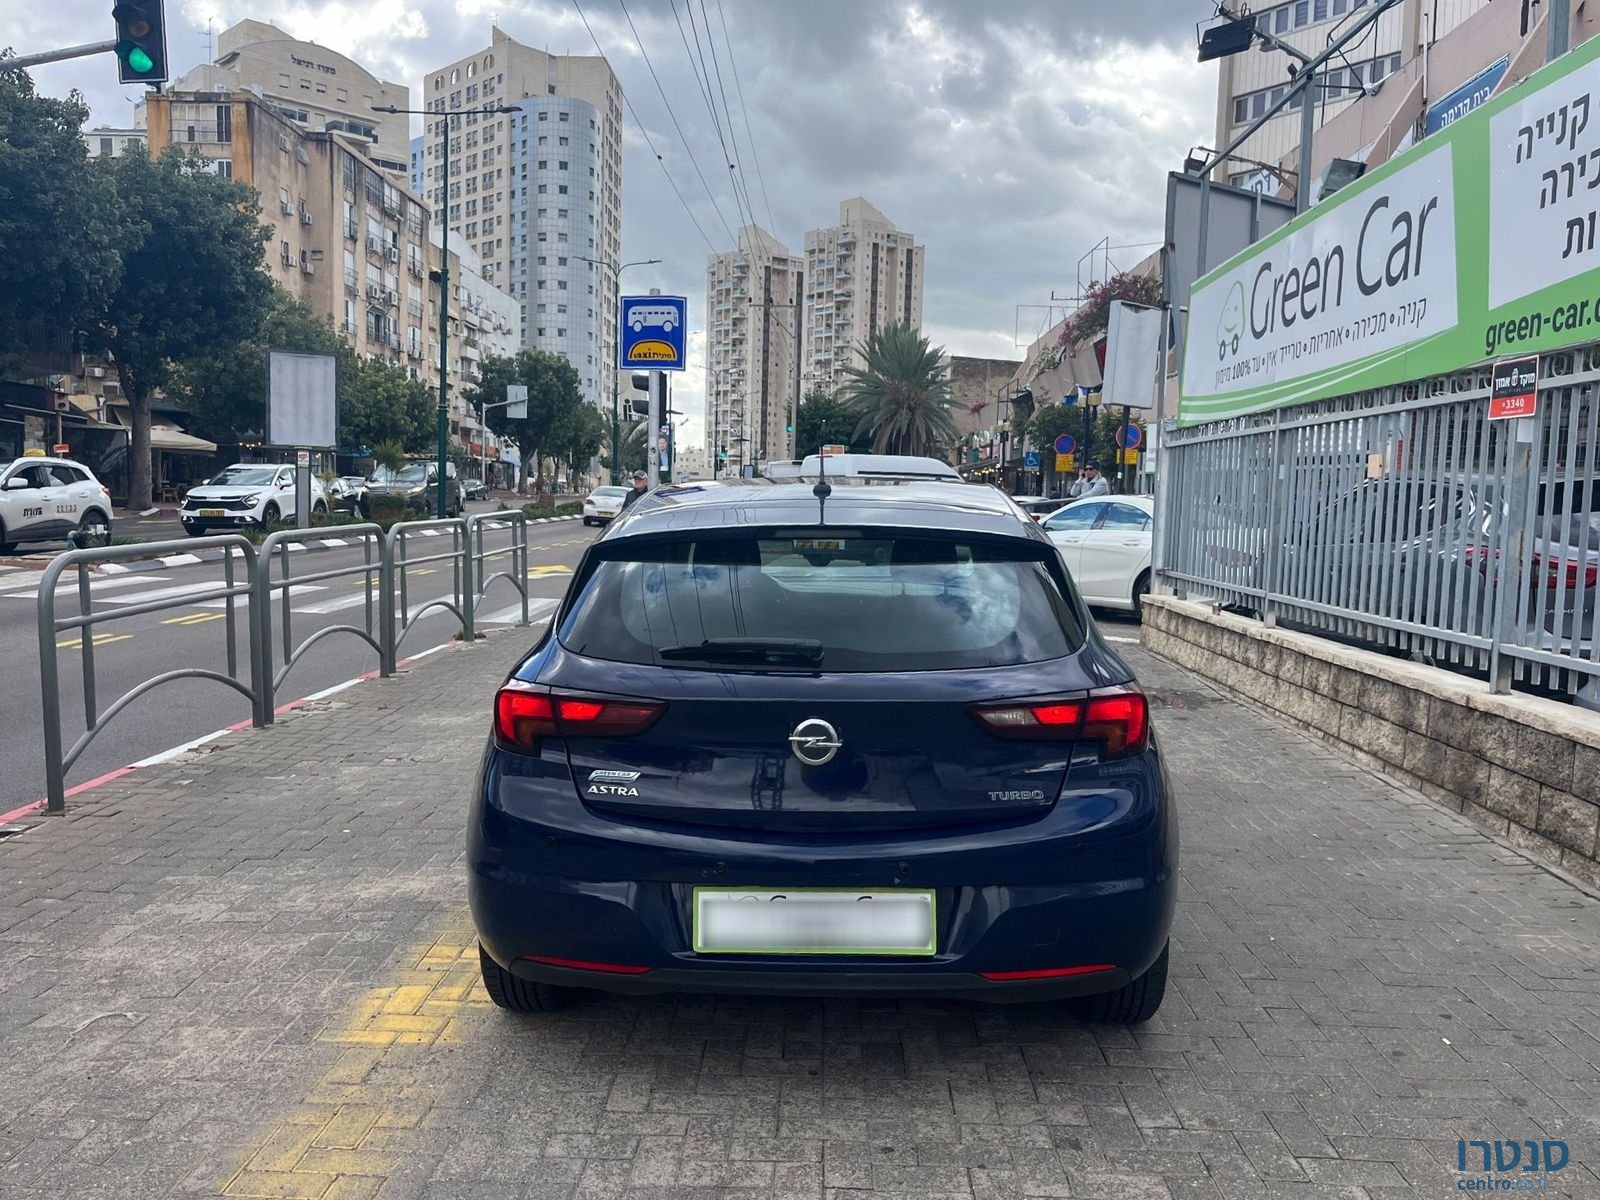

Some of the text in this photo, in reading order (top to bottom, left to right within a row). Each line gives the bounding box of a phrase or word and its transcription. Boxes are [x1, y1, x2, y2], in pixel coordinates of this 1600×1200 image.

[1441, 86, 1490, 127] בית קדימה
[1516, 93, 1590, 164] קנייה
[1250, 196, 1438, 340] Green Car
[1352, 312, 1387, 341] מכירה
[1397, 298, 1427, 328] קניה
[1280, 341, 1302, 364] טרייד
[1308, 326, 1344, 355] אחריות
[1232, 359, 1251, 380] 100%
[1252, 355, 1261, 373] עד
[1266, 349, 1278, 374] אין
[588, 785, 639, 797] ASTRA
[988, 790, 1044, 801] TURBO
